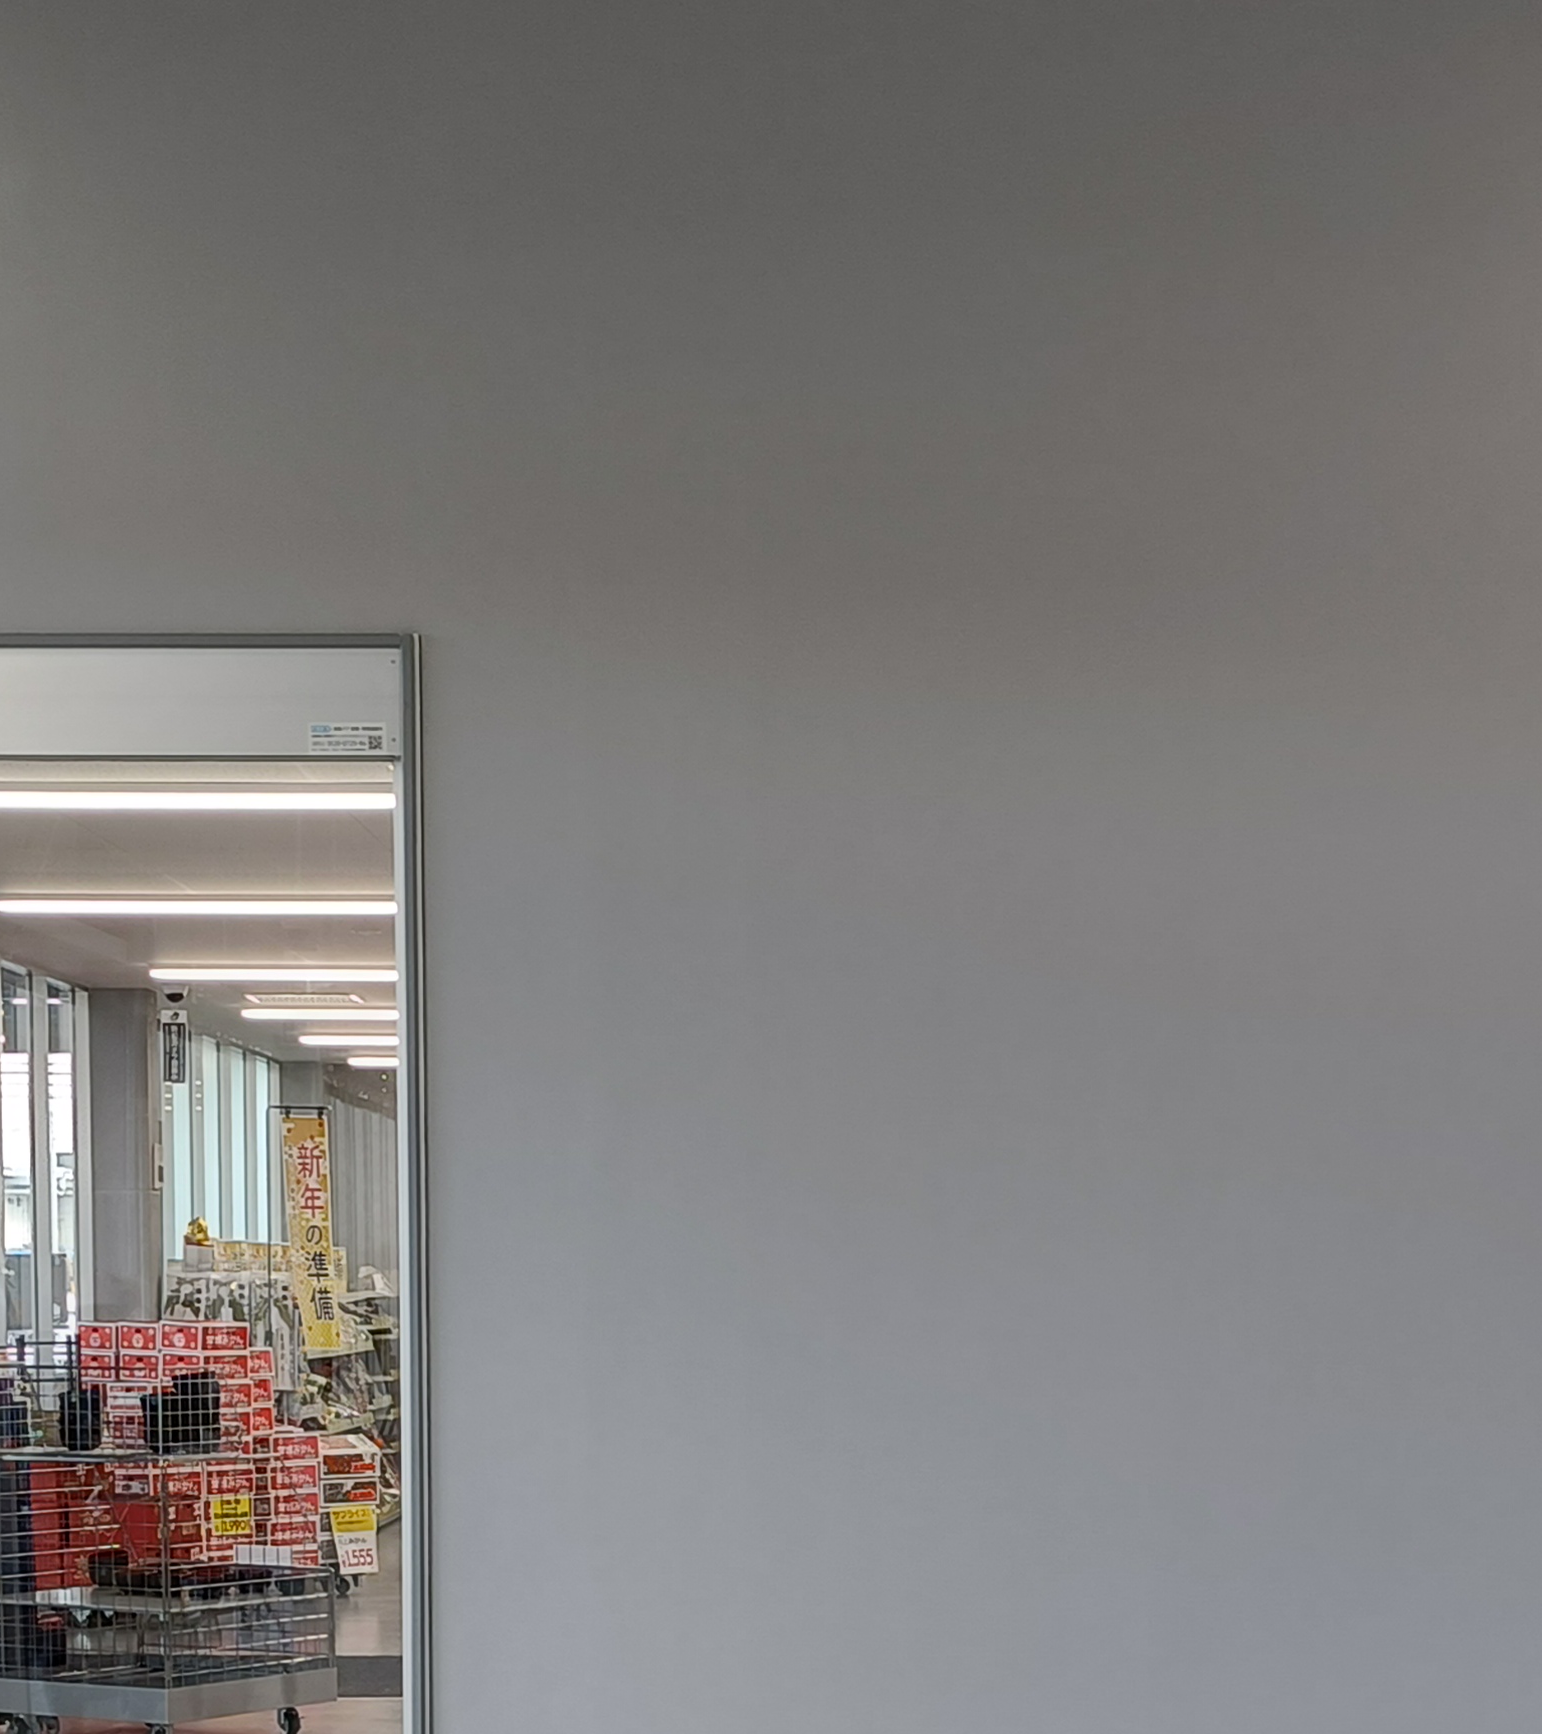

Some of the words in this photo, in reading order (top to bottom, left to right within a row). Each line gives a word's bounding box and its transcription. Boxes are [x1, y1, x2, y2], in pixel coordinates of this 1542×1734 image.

[297, 1143, 335, 1321] 新年の準備
